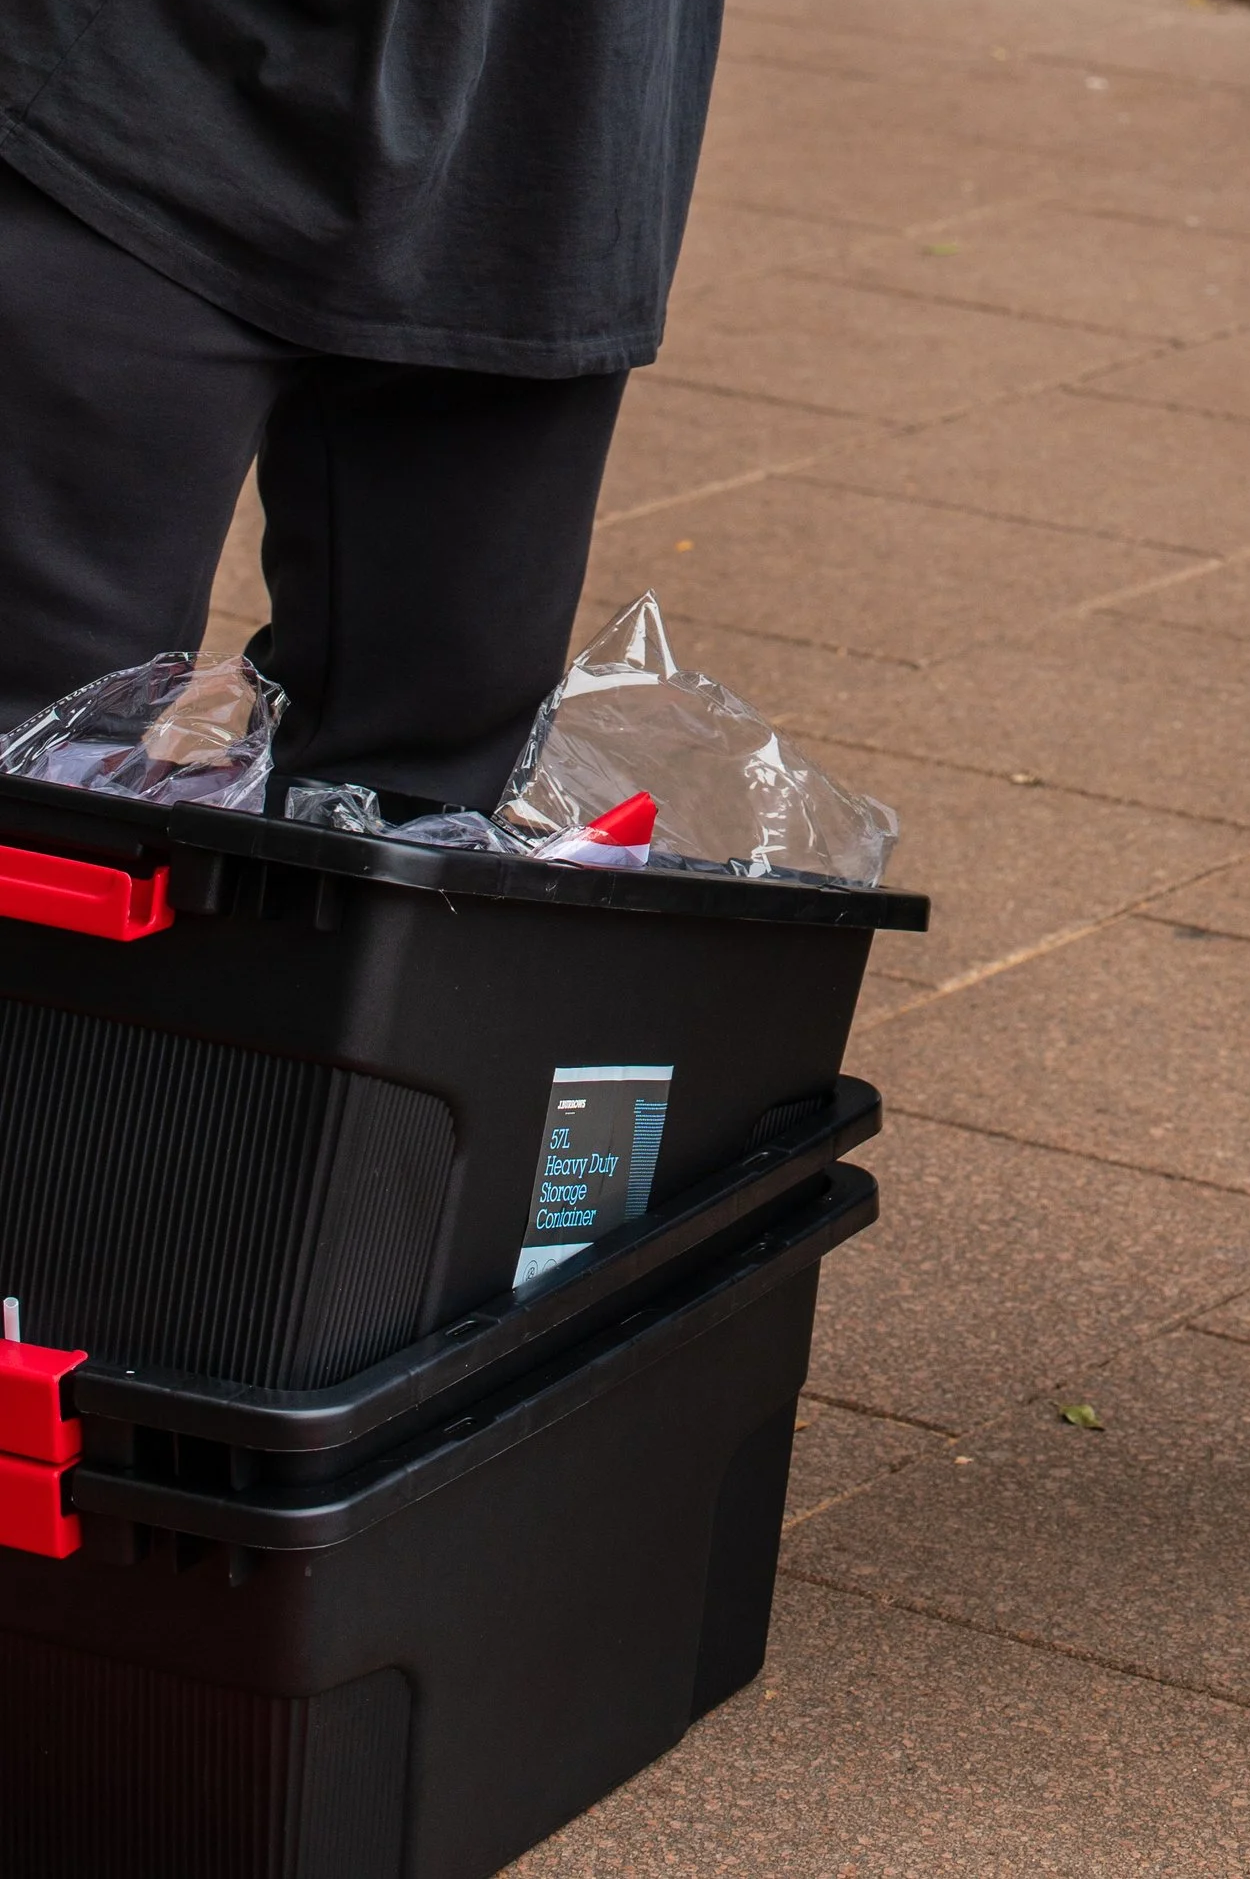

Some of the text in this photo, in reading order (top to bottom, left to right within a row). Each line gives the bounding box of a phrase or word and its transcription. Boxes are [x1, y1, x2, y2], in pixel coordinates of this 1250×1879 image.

[550, 1128, 570, 1149] 57L
[544, 1153, 619, 1178] Heavy Duty
[540, 1182, 587, 1205] Storage
[536, 1207, 597, 1229] Container
